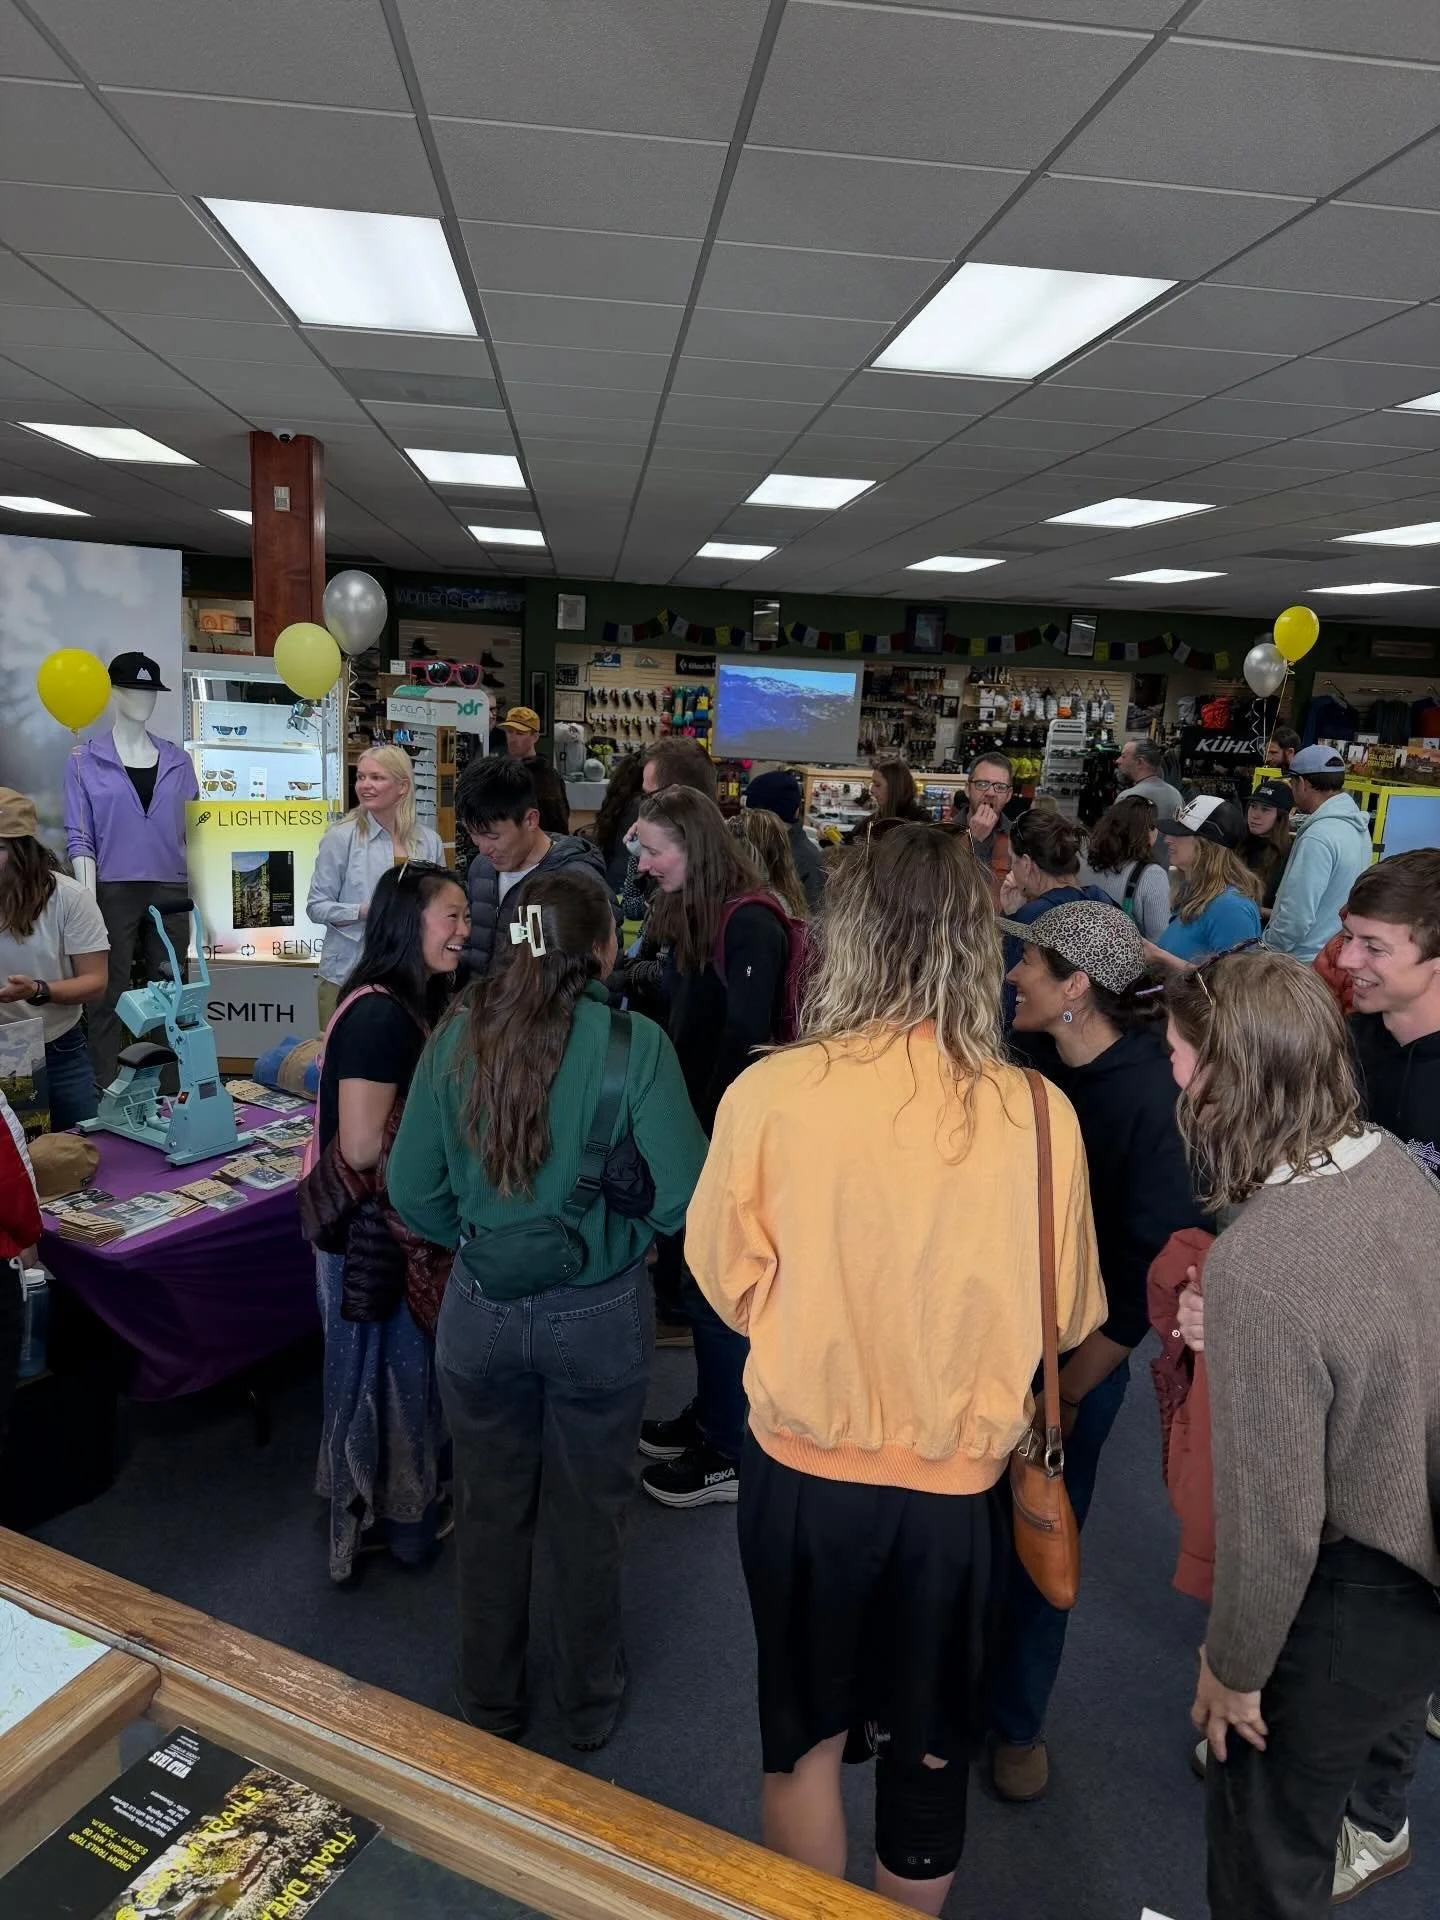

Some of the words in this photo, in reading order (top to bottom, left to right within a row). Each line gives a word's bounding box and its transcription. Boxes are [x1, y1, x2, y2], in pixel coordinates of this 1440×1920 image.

[1194, 735, 1253, 754] KÜHL
[218, 810, 323, 827] LIGHTNESS
[272, 938, 324, 956] BEING
[207, 1001, 294, 1023] SMITH
[704, 1467, 736, 1486] HOKA
[147, 1749, 174, 1769] IRIS
[165, 1759, 193, 1779] WILD
[143, 1813, 156, 1823] Talk
[144, 1804, 165, 1818] Signing
[197, 1786, 264, 1845] TRAILS
[66, 1831, 88, 1846] TOUR
[80, 1826, 94, 1836] 09
[90, 1831, 108, 1844] MAY
[100, 1825, 119, 1838] 7:30
[83, 1841, 110, 1859] TRAILS
[102, 1839, 141, 1864] SATURDAY,
[130, 1842, 149, 1855] 5:30
[301, 1831, 357, 1875] TRAIL
[105, 1853, 132, 1871] DREAM
